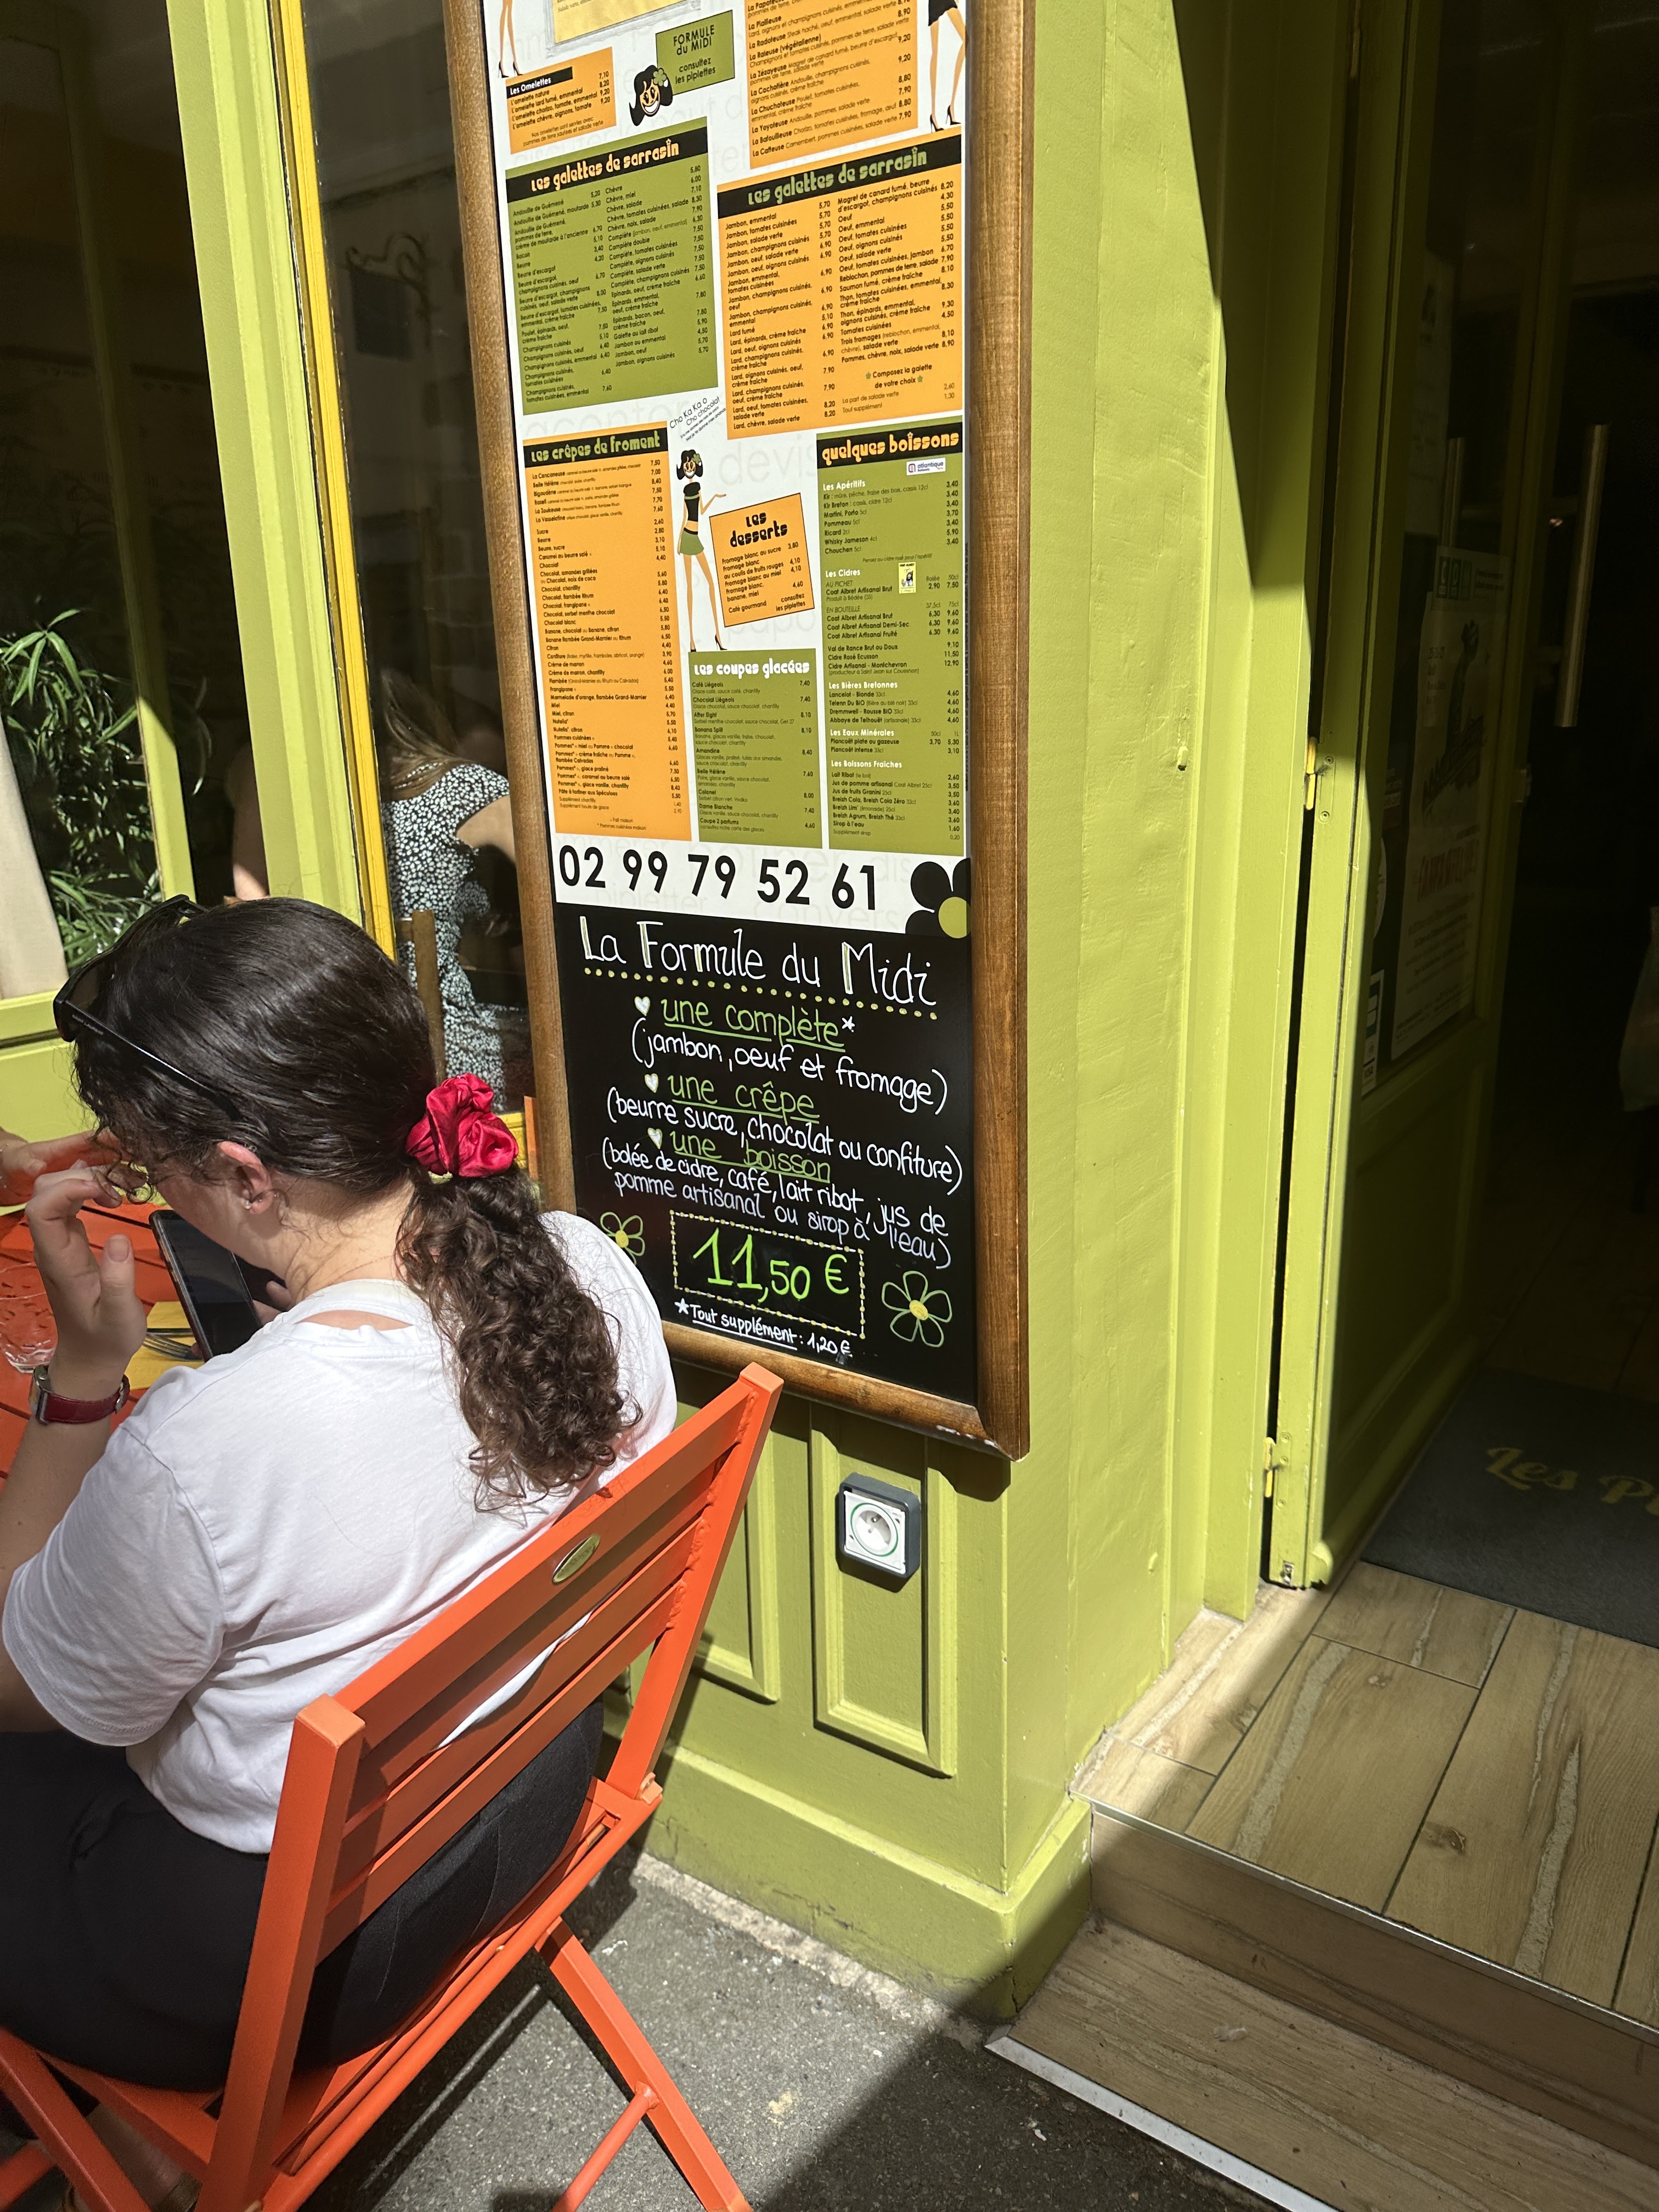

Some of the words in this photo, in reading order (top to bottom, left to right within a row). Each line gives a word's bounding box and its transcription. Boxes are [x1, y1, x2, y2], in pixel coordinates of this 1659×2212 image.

[673, 24, 714, 46] FORMULE
[676, 43, 687, 55] du
[691, 36, 711, 51] MIDI
[675, 76, 685, 84] les
[686, 67, 715, 83] piplettes
[679, 58, 711, 72] consultez
[521, 77, 551, 92] Omelettes
[531, 176, 550, 191] Les
[553, 160, 602, 191] galettes
[606, 153, 620, 172] de
[623, 138, 679, 168] sarrasin
[748, 189, 770, 205] Les
[774, 171, 834, 204] galettes
[838, 163, 855, 183] de
[859, 146, 927, 179] sarrasin
[725, 221, 748, 230] Jambon,
[749, 212, 776, 224] emmental
[819, 200, 830, 208] 5,70
[838, 213, 852, 222] Oeuf
[940, 191, 953, 200] 4,30
[726, 230, 748, 239] Jambon,
[749, 225, 771, 234] tomates
[772, 218, 797, 229] cuisinées
[819, 210, 830, 219] 5,70
[840, 326, 864, 335] Tomates
[865, 321, 891, 331] cuisinées
[941, 310, 954, 318] 4,50
[872, 369, 903, 378] Composez
[911, 363, 932, 374] galette
[670, 416, 683, 428] Cho
[686, 415, 697, 426] Cho
[697, 396, 720, 417] chocolat
[531, 450, 549, 462] Les
[552, 444, 591, 462] crêpes
[594, 437, 608, 454] de
[610, 430, 660, 453] froment
[822, 439, 885, 466] quelques
[889, 431, 959, 453] boissons
[917, 461, 943, 470] atlantique
[836, 479, 865, 490] Apéritifs
[730, 520, 787, 547] desserts
[746, 512, 766, 527] Les
[721, 555, 743, 564] Fromage
[838, 568, 860, 577] Cidres
[741, 600, 766, 612] gourmand
[694, 664, 713, 675] Les
[716, 663, 759, 679] coupes
[762, 658, 809, 679] glacées
[860, 728, 894, 736] Minérales
[560, 845, 606, 888] 02
[623, 849, 668, 893] 99
[688, 854, 736, 899] 79
[757, 859, 810, 905] 52
[832, 862, 875, 911] 61
[579, 916, 627, 964] La
[636, 921, 766, 979] Formule
[782, 942, 821, 988] du
[841, 941, 936, 1006] Midi
[661, 998, 713, 1026] une
[800, 1053, 825, 1081] et
[836, 1056, 947, 1115] fromage)
[667, 1075, 718, 1104] une
[735, 1080, 820, 1125] crêpe
[607, 1086, 679, 1124] (beurre
[747, 1113, 834, 1155] chocolat
[839, 1140, 862, 1160] ou
[866, 1141, 963, 1195] confiture)
[669, 1131, 722, 1159] une
[743, 1139, 831, 1182] boisson
[602, 1136, 653, 1170] (bolée
[656, 1150, 677, 1172] de
[778, 1172, 813, 1203] lait
[873, 1197, 911, 1234] jus
[920, 1205, 949, 1236] de
[614, 1172, 678, 1198] pomme
[682, 1183, 765, 1218] artisanal
[774, 1205, 799, 1225] ou
[808, 1210, 850, 1245] sirop
[854, 1217, 870, 1240] à
[692, 1227, 811, 1303] 11,50
[825, 1254, 850, 1295] €
[720, 1314, 797, 1344] supplément
[1484, 1446, 1579, 1491] Les
